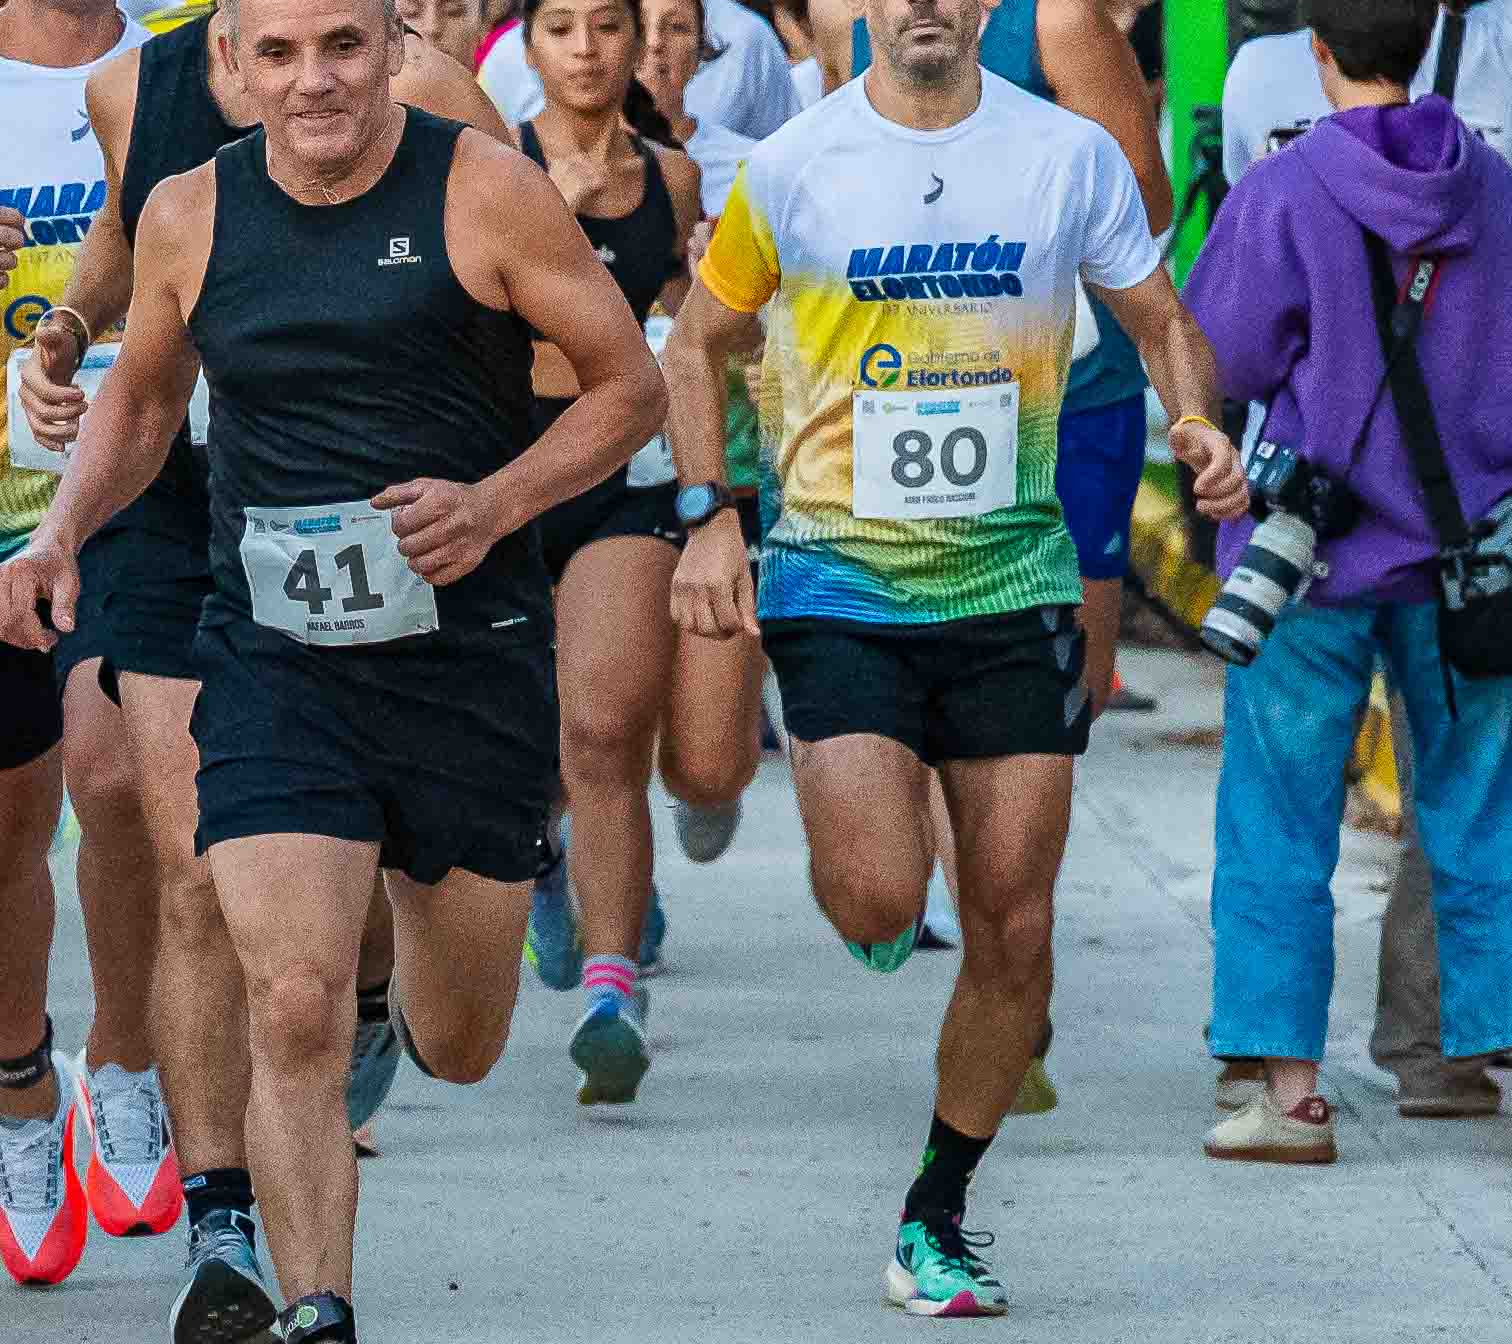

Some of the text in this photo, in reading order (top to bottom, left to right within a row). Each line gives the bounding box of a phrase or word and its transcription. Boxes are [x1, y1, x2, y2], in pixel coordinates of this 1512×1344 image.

[847, 234, 1027, 279] MARATÓN
[907, 367, 1013, 387] Elortondo
[890, 429, 988, 488] 80
[282, 543, 385, 615] 41
